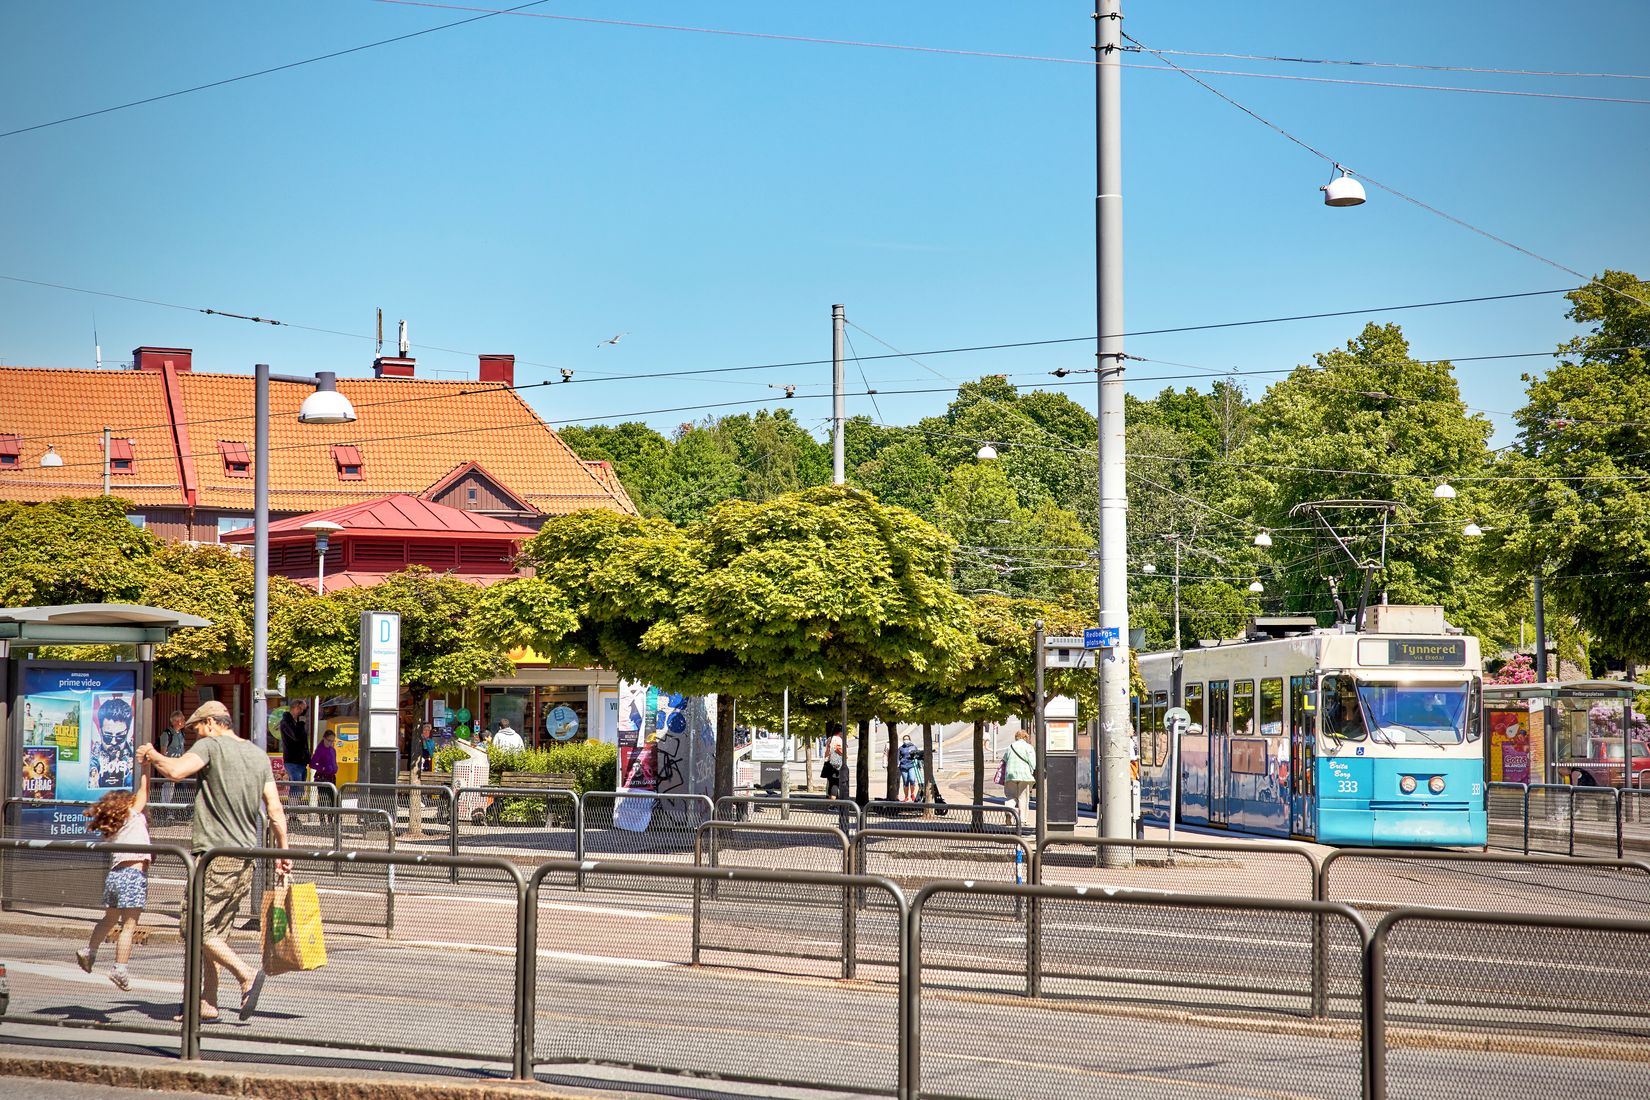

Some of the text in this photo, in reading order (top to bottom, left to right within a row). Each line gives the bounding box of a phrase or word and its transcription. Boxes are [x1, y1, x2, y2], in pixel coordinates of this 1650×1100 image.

[380, 619, 391, 643] D
[1085, 631, 1117, 639] Redbergs-
[1402, 644, 1456, 655] Tynnered
[59, 678, 101, 688] prime video
[1329, 761, 1349, 769] Brita
[1334, 770, 1351, 779] Borg
[23, 778, 52, 790] FLEABAG
[1337, 780, 1358, 793] 333
[1471, 783, 1480, 795] 333
[50, 824, 58, 835] Is
